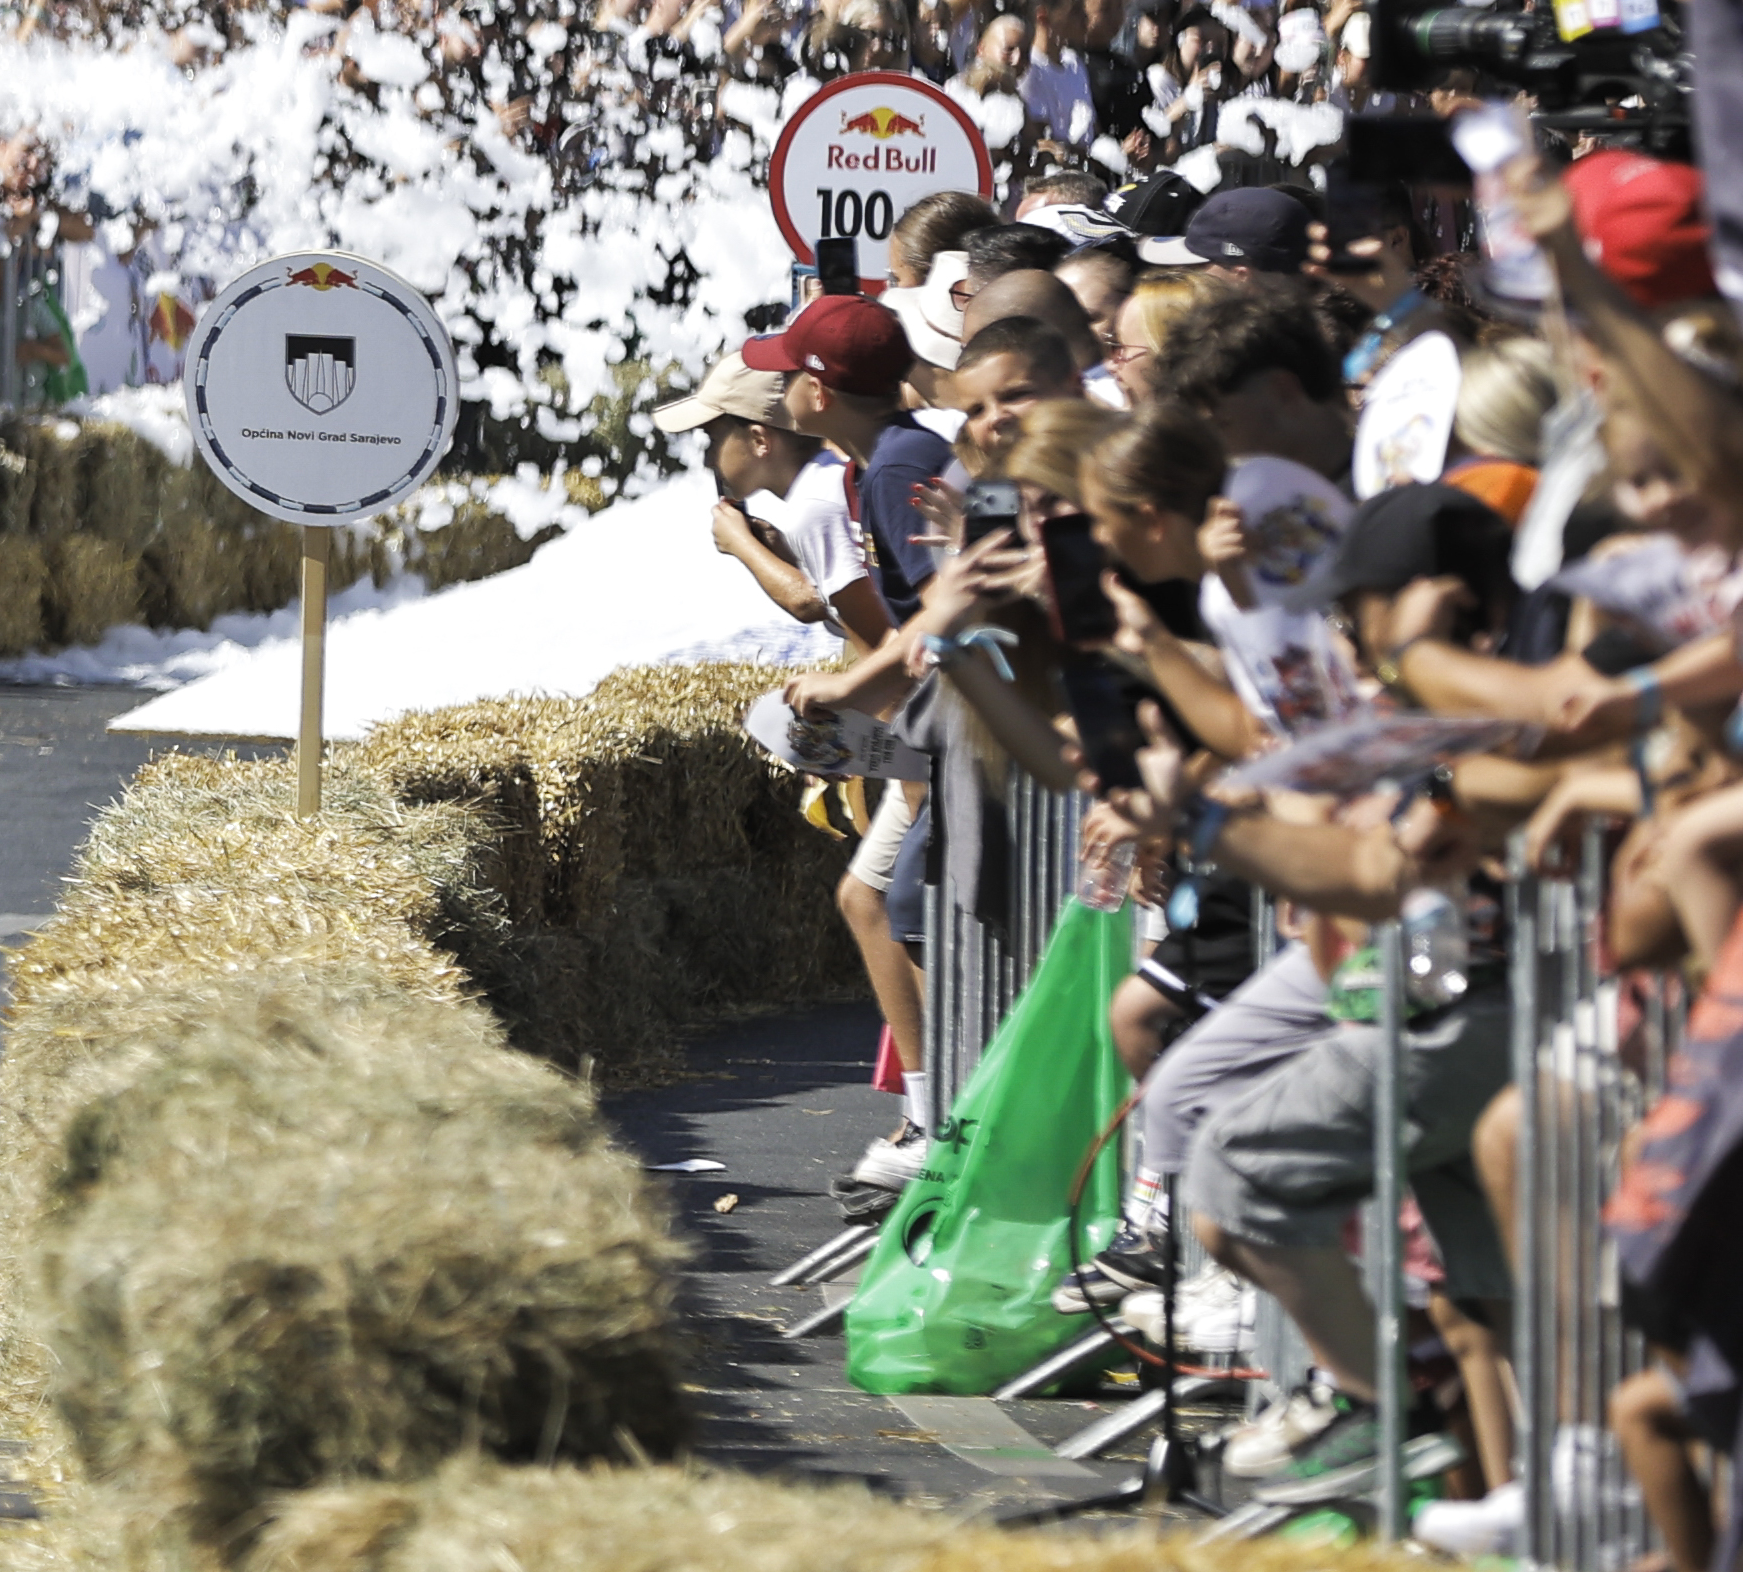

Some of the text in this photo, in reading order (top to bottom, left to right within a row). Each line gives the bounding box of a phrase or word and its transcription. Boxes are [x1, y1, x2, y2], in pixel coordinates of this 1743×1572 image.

[827, 144, 937, 174] Red Bull
[816, 187, 894, 241] 100
[241, 427, 402, 445] Općina Novi Grad Sarajevo
